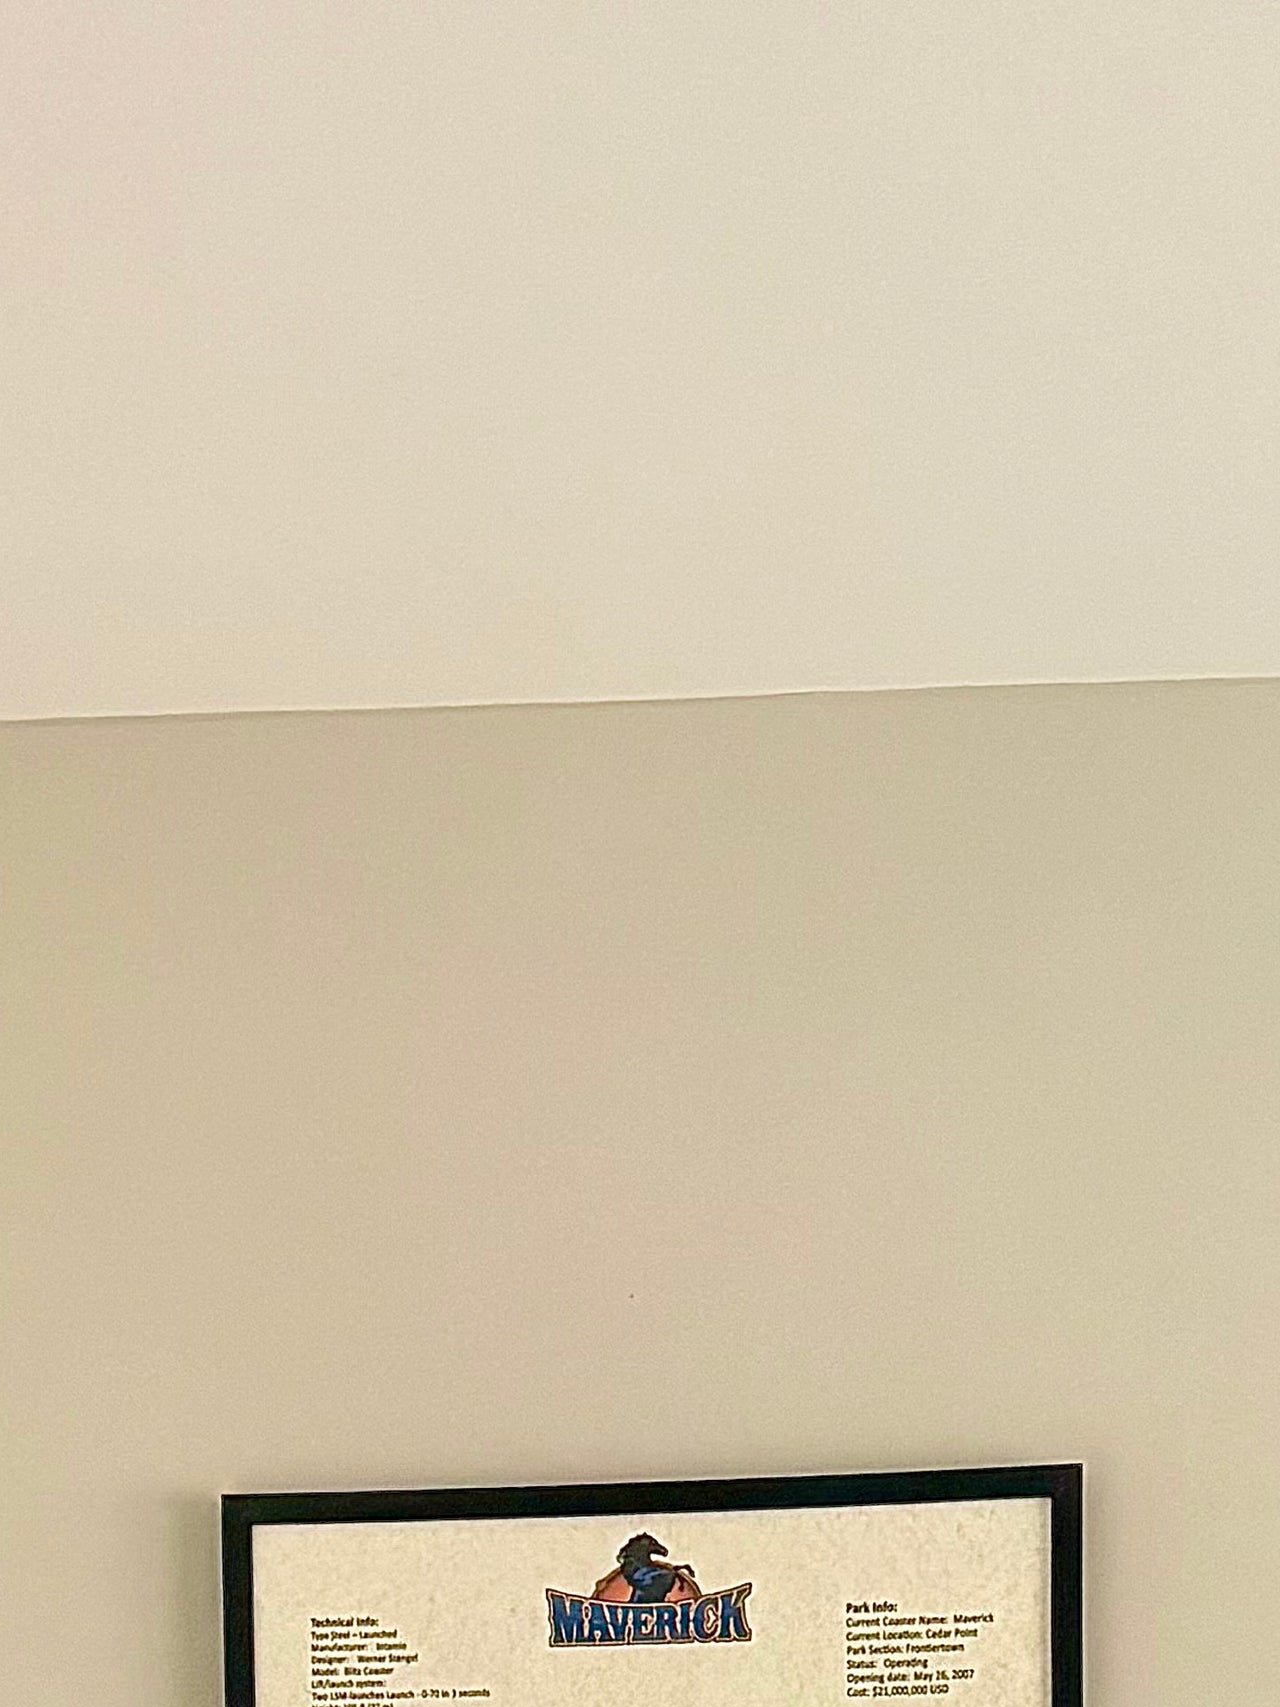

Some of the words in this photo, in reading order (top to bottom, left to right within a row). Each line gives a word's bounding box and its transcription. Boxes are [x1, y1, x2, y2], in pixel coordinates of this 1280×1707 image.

[846, 1602, 870, 1614] Park
[873, 1601, 897, 1613] Info:
[550, 1589, 750, 1642] MAVERICK
[846, 1617, 880, 1627] Current
[883, 1616, 916, 1625] Coaster
[920, 1616, 947, 1625] Name:
[954, 1613, 993, 1623] Maverick
[311, 1618, 354, 1627] Technical
[357, 1617, 379, 1627] Info:
[331, 1631, 350, 1641] Steel
[359, 1629, 397, 1639] Launched
[846, 1631, 880, 1641] Current
[883, 1630, 923, 1640] Location:
[926, 1629, 951, 1639] Cedar
[955, 1628, 977, 1638] Point
[847, 1645, 865, 1655] Park
[869, 1645, 904, 1654] Section:
[906, 1643, 965, 1653] Frontiertown
[358, 1655, 386, 1663] Werner
[847, 1660, 877, 1669] Status:
[883, 1658, 928, 1669] Operating
[312, 1668, 339, 1676] Model:
[364, 1667, 394, 1675] Coaster
[847, 1673, 884, 1684] Opening
[887, 1672, 910, 1681] date:
[914, 1672, 933, 1682] May
[952, 1669, 975, 1680] 2007
[847, 1687, 869, 1697] Cost:
[873, 1686, 927, 1697] $21,000,000
[930, 1684, 949, 1694] USD
